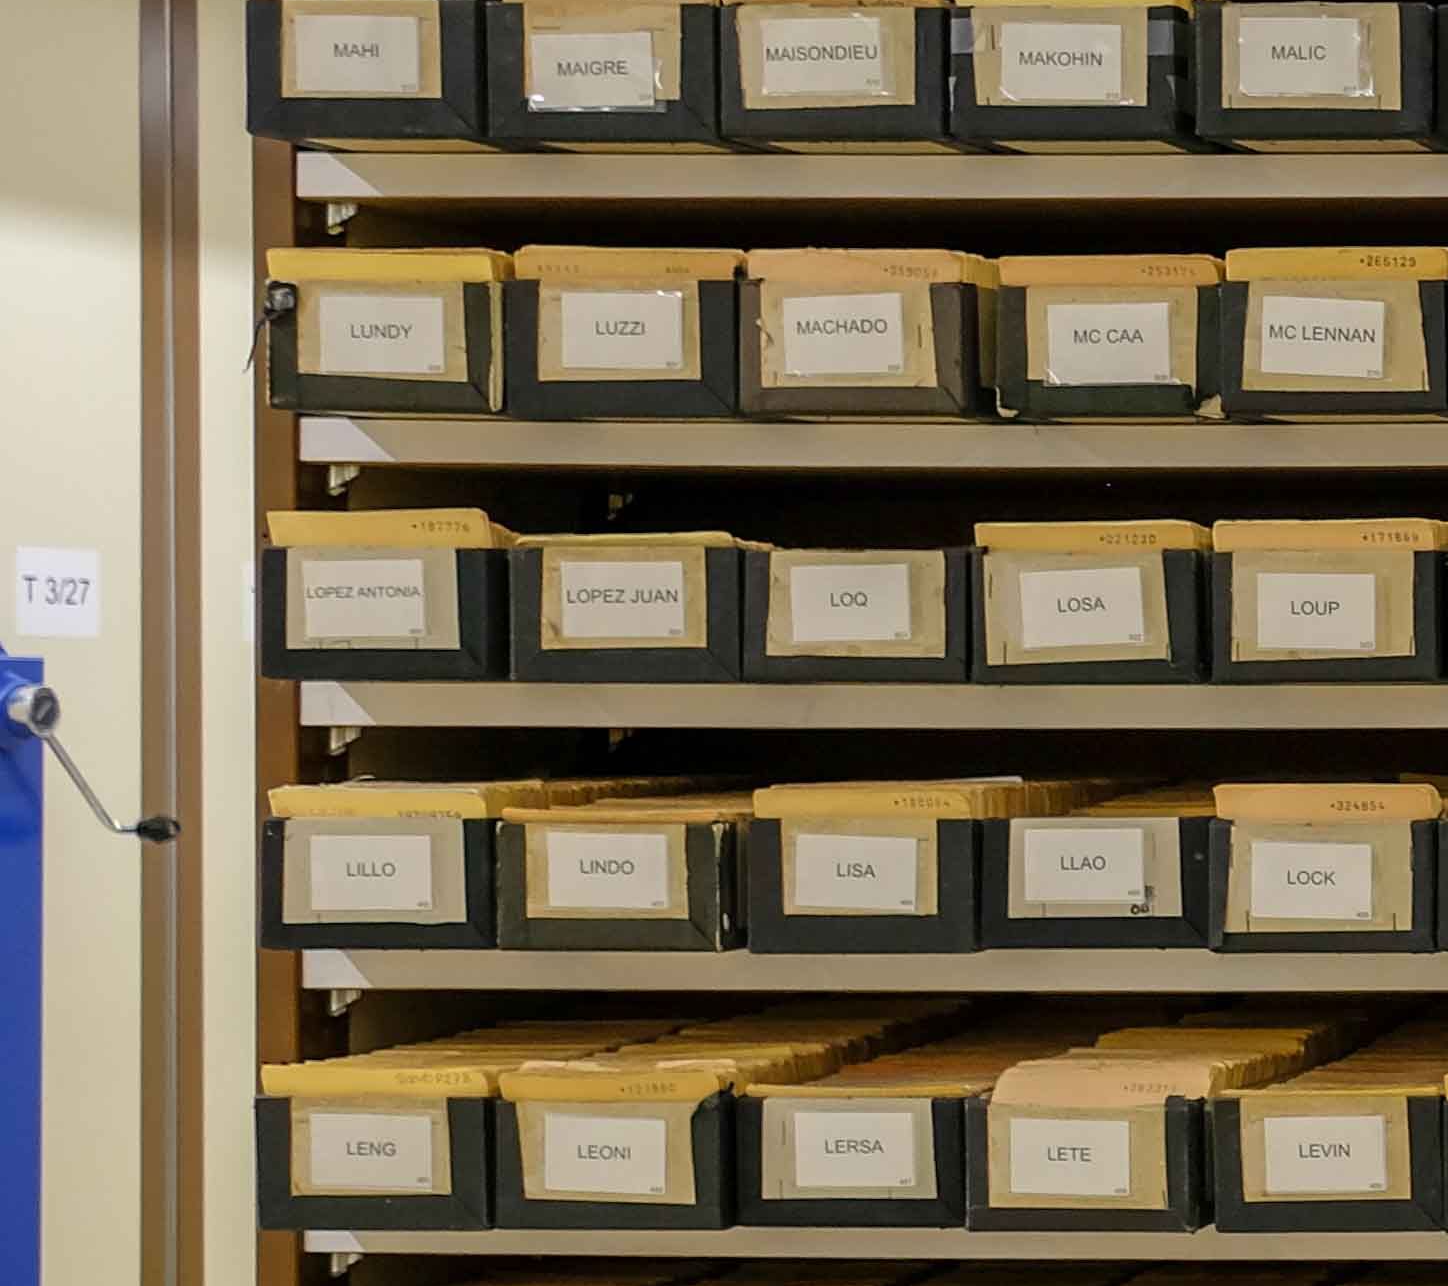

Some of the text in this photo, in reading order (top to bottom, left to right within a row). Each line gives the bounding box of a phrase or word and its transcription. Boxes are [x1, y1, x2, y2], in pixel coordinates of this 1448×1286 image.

[765, 44, 878, 62] MAISONDIEU
[796, 318, 888, 336] MACHADO
[1269, 324, 1376, 344] MC LENNAN
[1073, 328, 1144, 345] MC CAA
[22, 574, 91, 606] T 3/27
[565, 588, 679, 605] LOPEZ JUAN
[830, 591, 869, 608] LOQ
[836, 862, 877, 879] LISA
[1287, 869, 1336, 886] LOCK
[824, 1139, 885, 1155] LERSA
